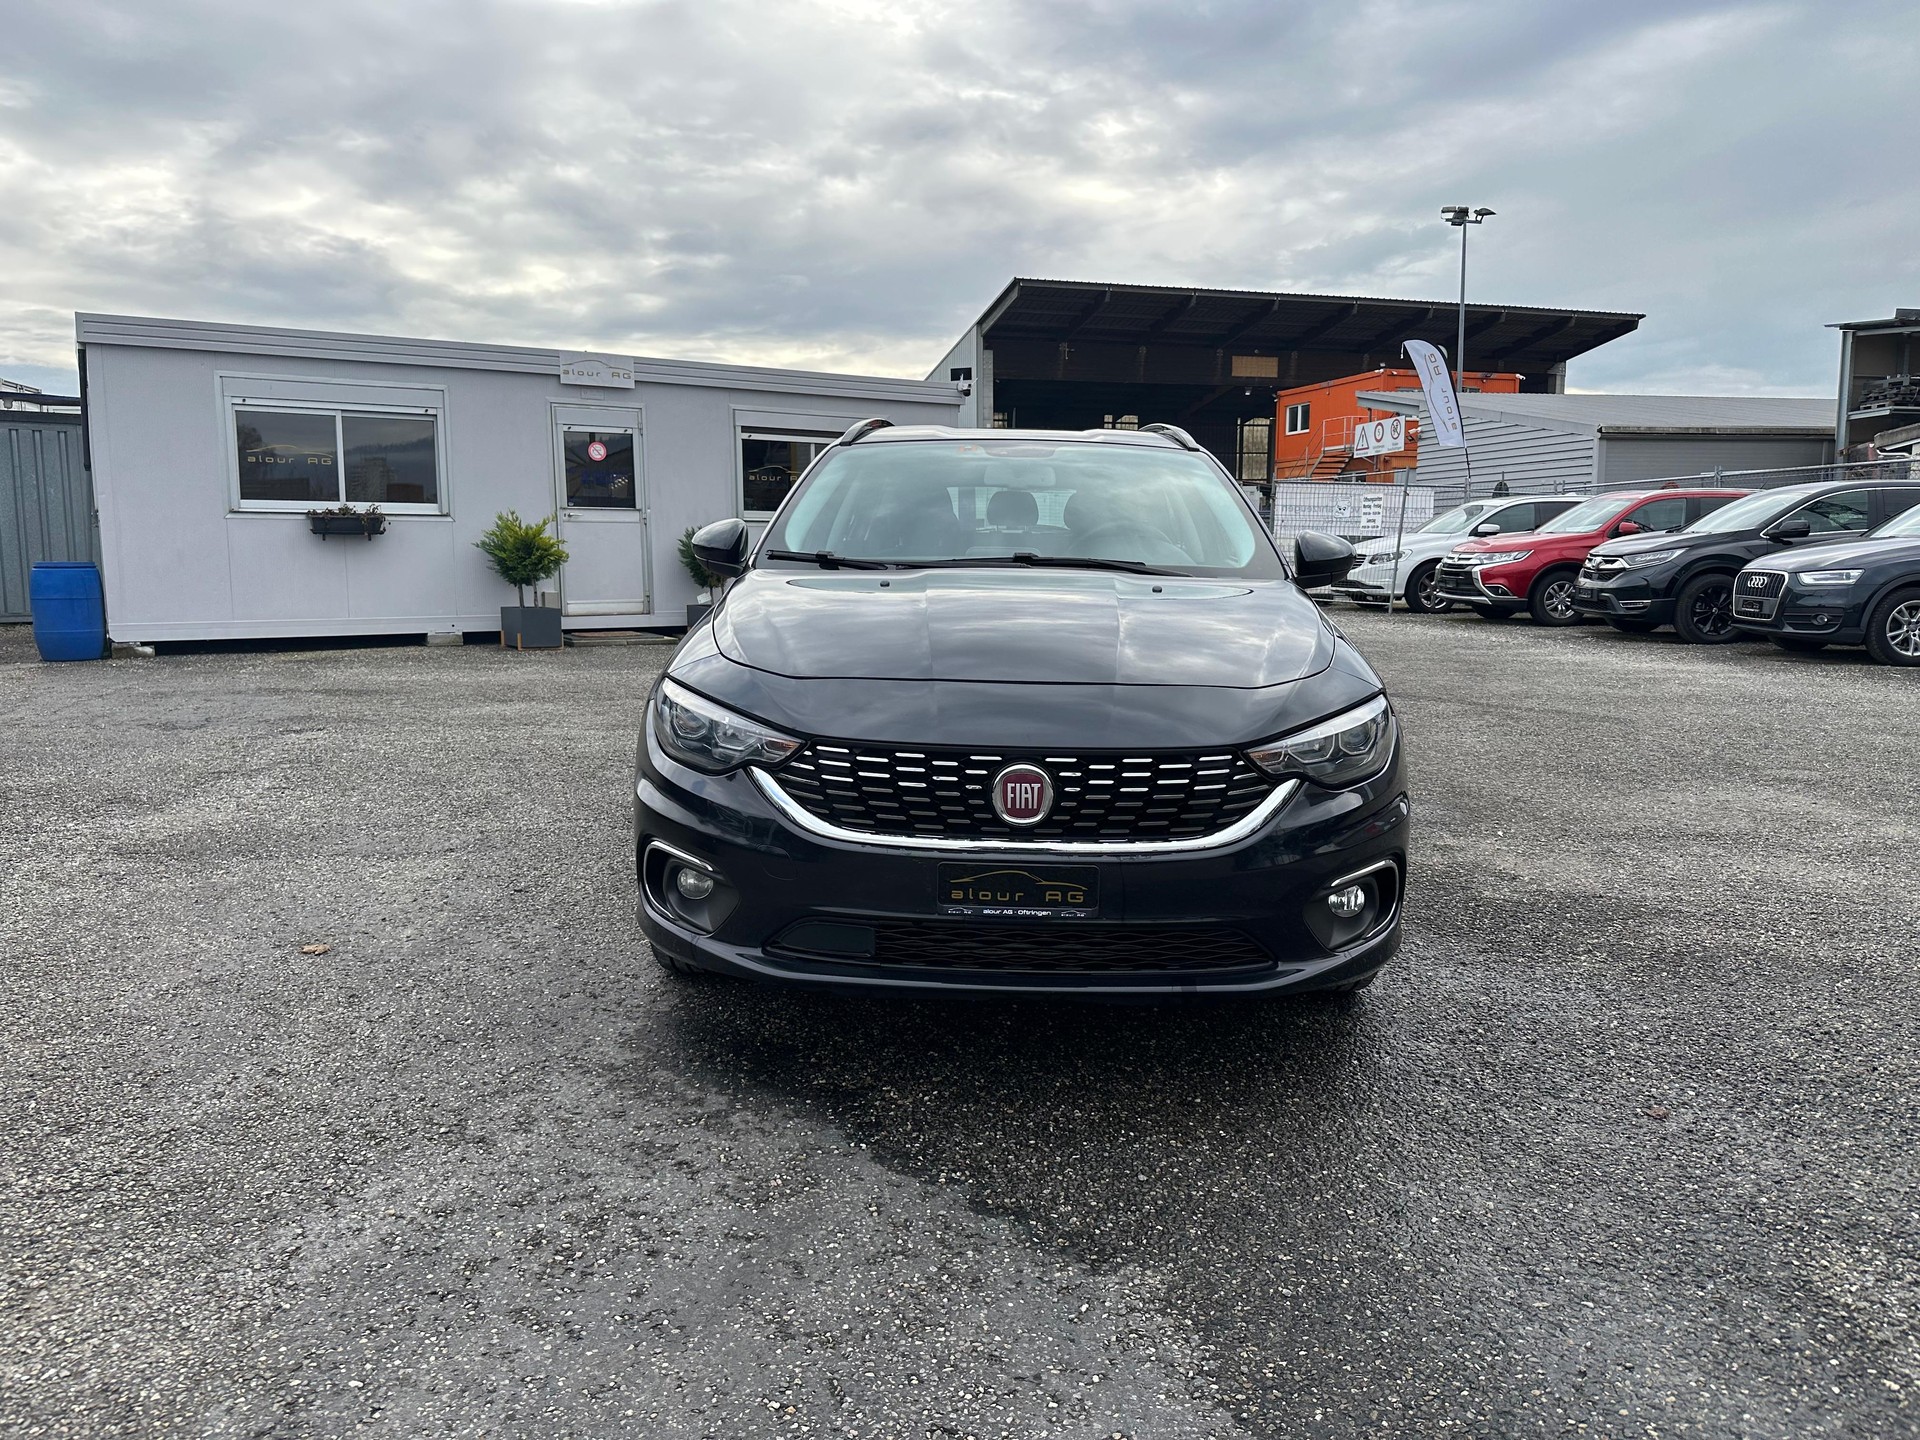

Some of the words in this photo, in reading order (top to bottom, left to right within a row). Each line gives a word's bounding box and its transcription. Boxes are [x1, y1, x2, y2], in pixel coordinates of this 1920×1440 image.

[1427, 353, 1442, 376] AG
[562, 369, 601, 377] alour
[611, 371, 632, 380] AG
[1441, 387, 1458, 431] alour
[247, 455, 295, 464] alour
[307, 457, 332, 465] AG
[748, 474, 782, 482] alour
[1007, 783, 1041, 809] FIAT
[951, 888, 1024, 901] alour
[1045, 891, 1084, 902] AG
[1018, 909, 1052, 917] Oftringen
